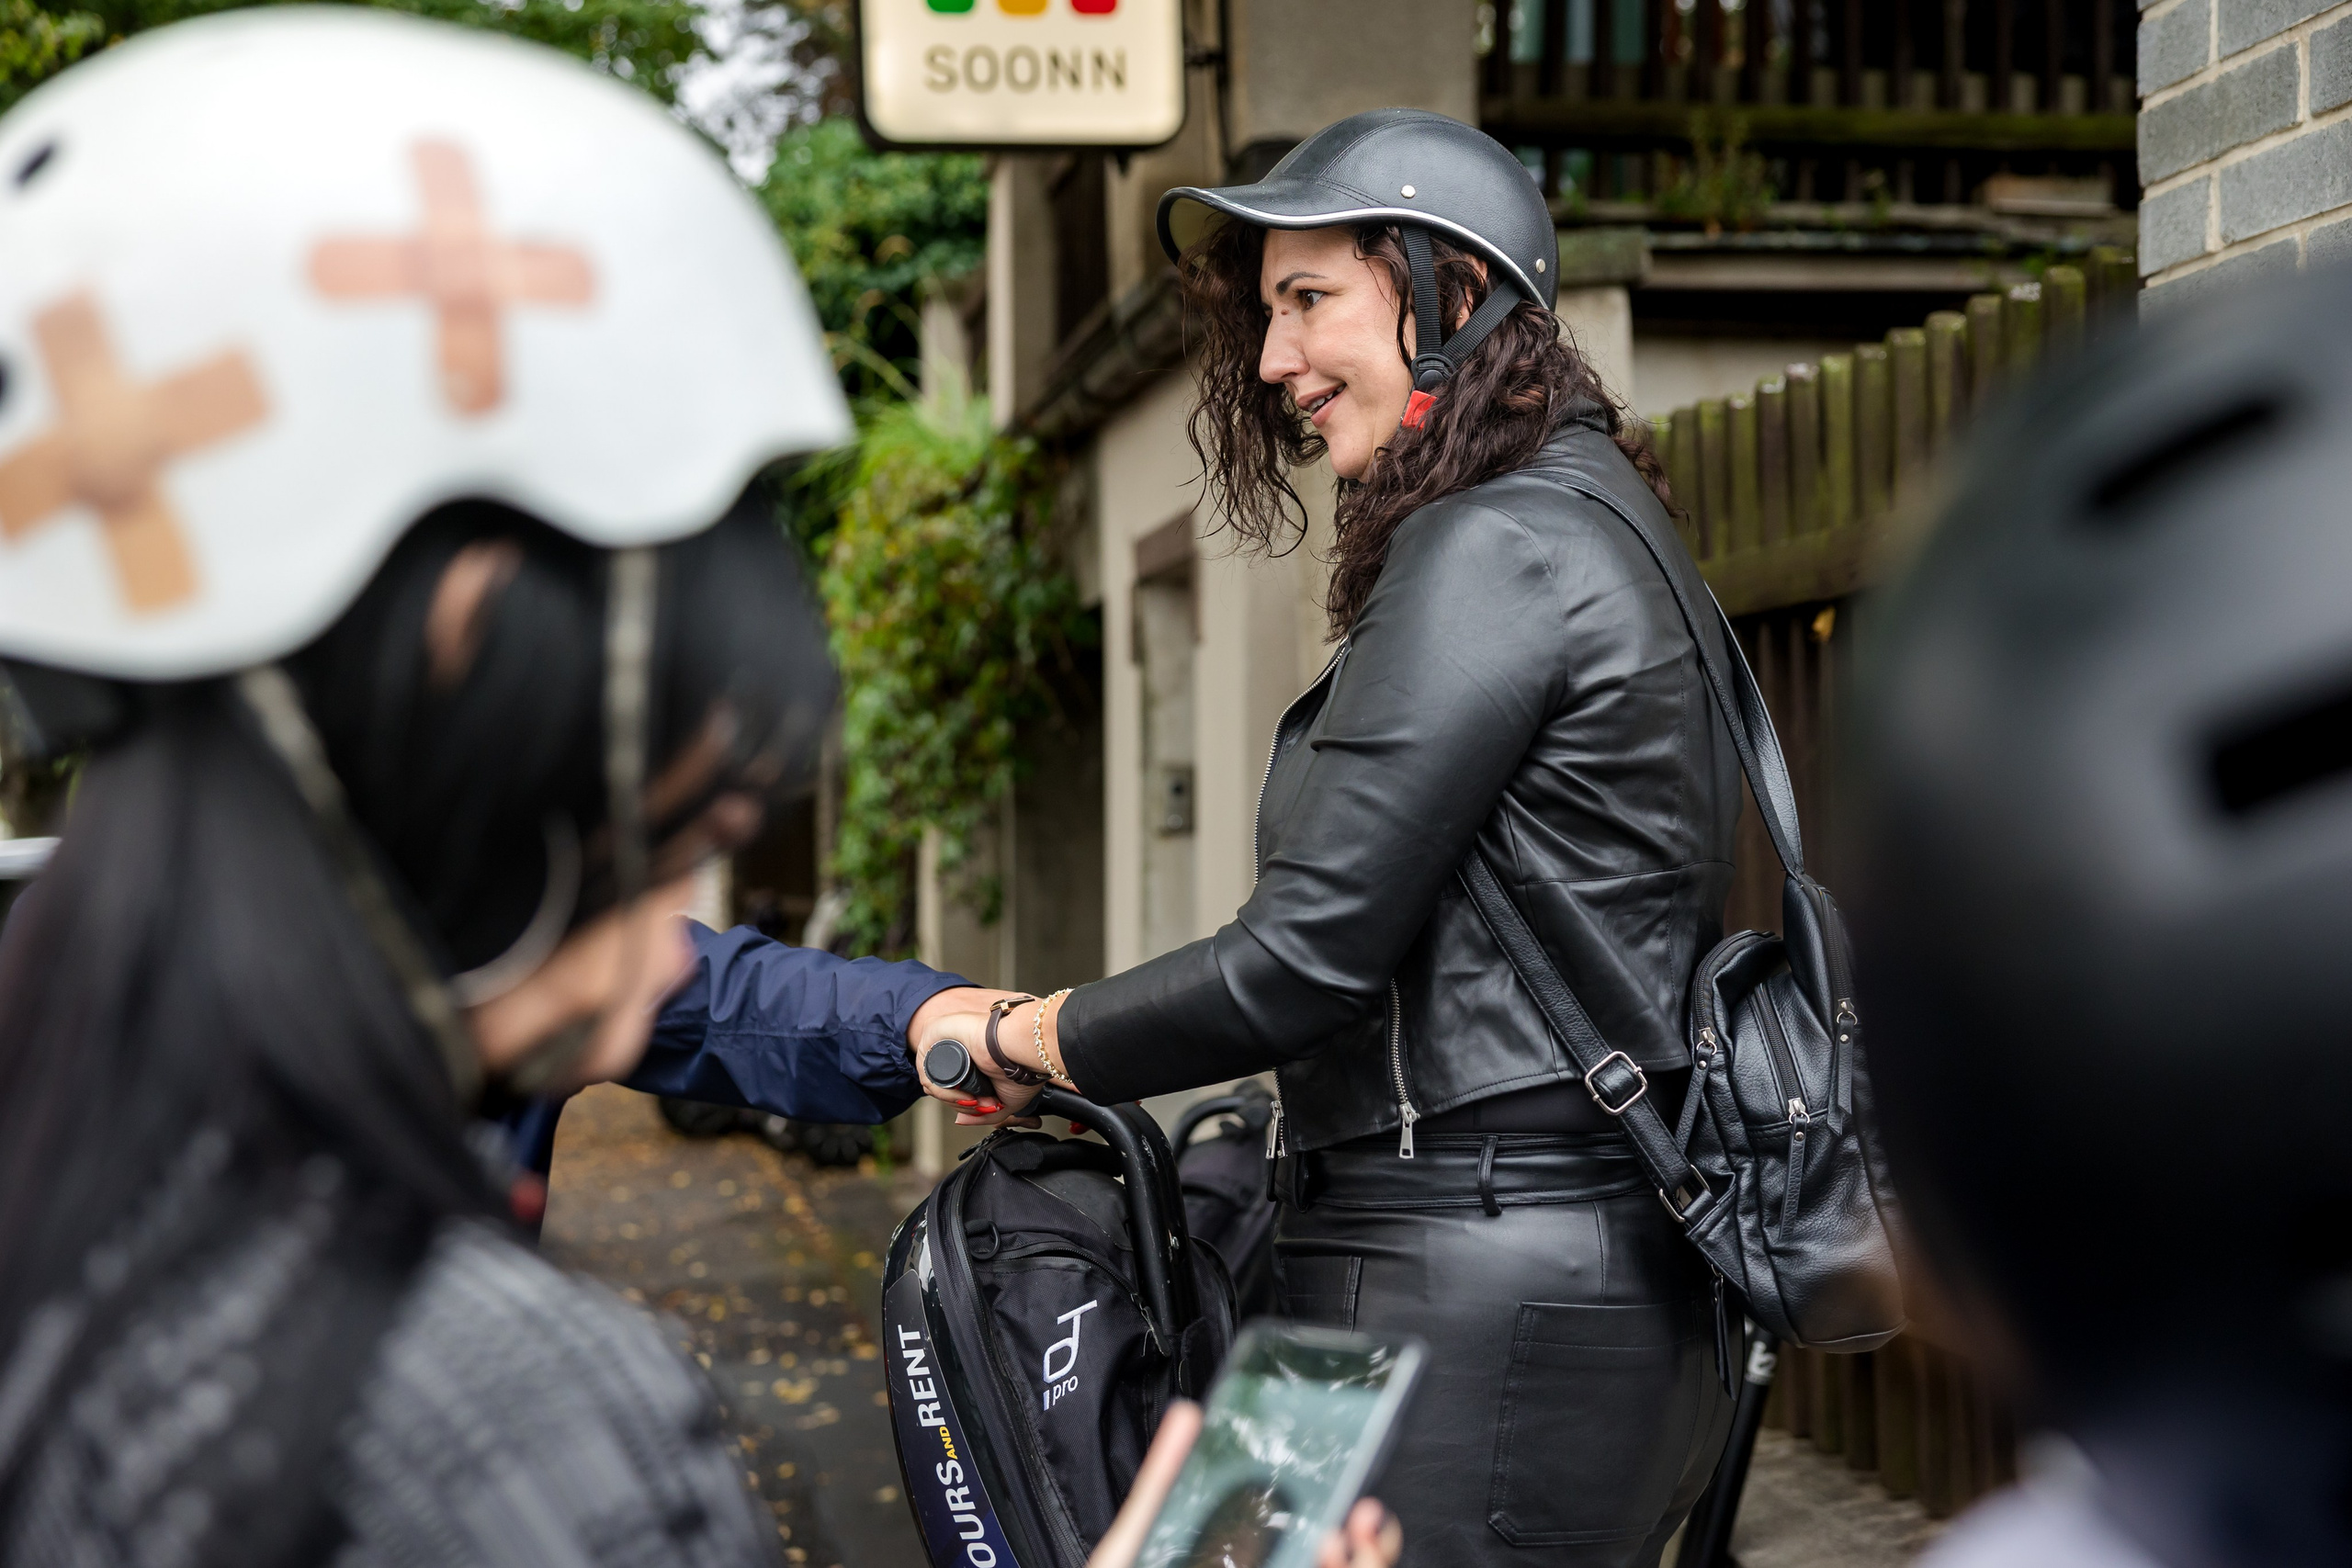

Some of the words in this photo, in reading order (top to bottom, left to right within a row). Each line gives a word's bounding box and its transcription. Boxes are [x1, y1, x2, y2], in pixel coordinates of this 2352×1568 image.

[923, 45, 1126, 92] SOONN
[898, 1324, 946, 1427] RENT
[939, 1426, 958, 1460] AND
[935, 1460, 997, 1568] OURS
